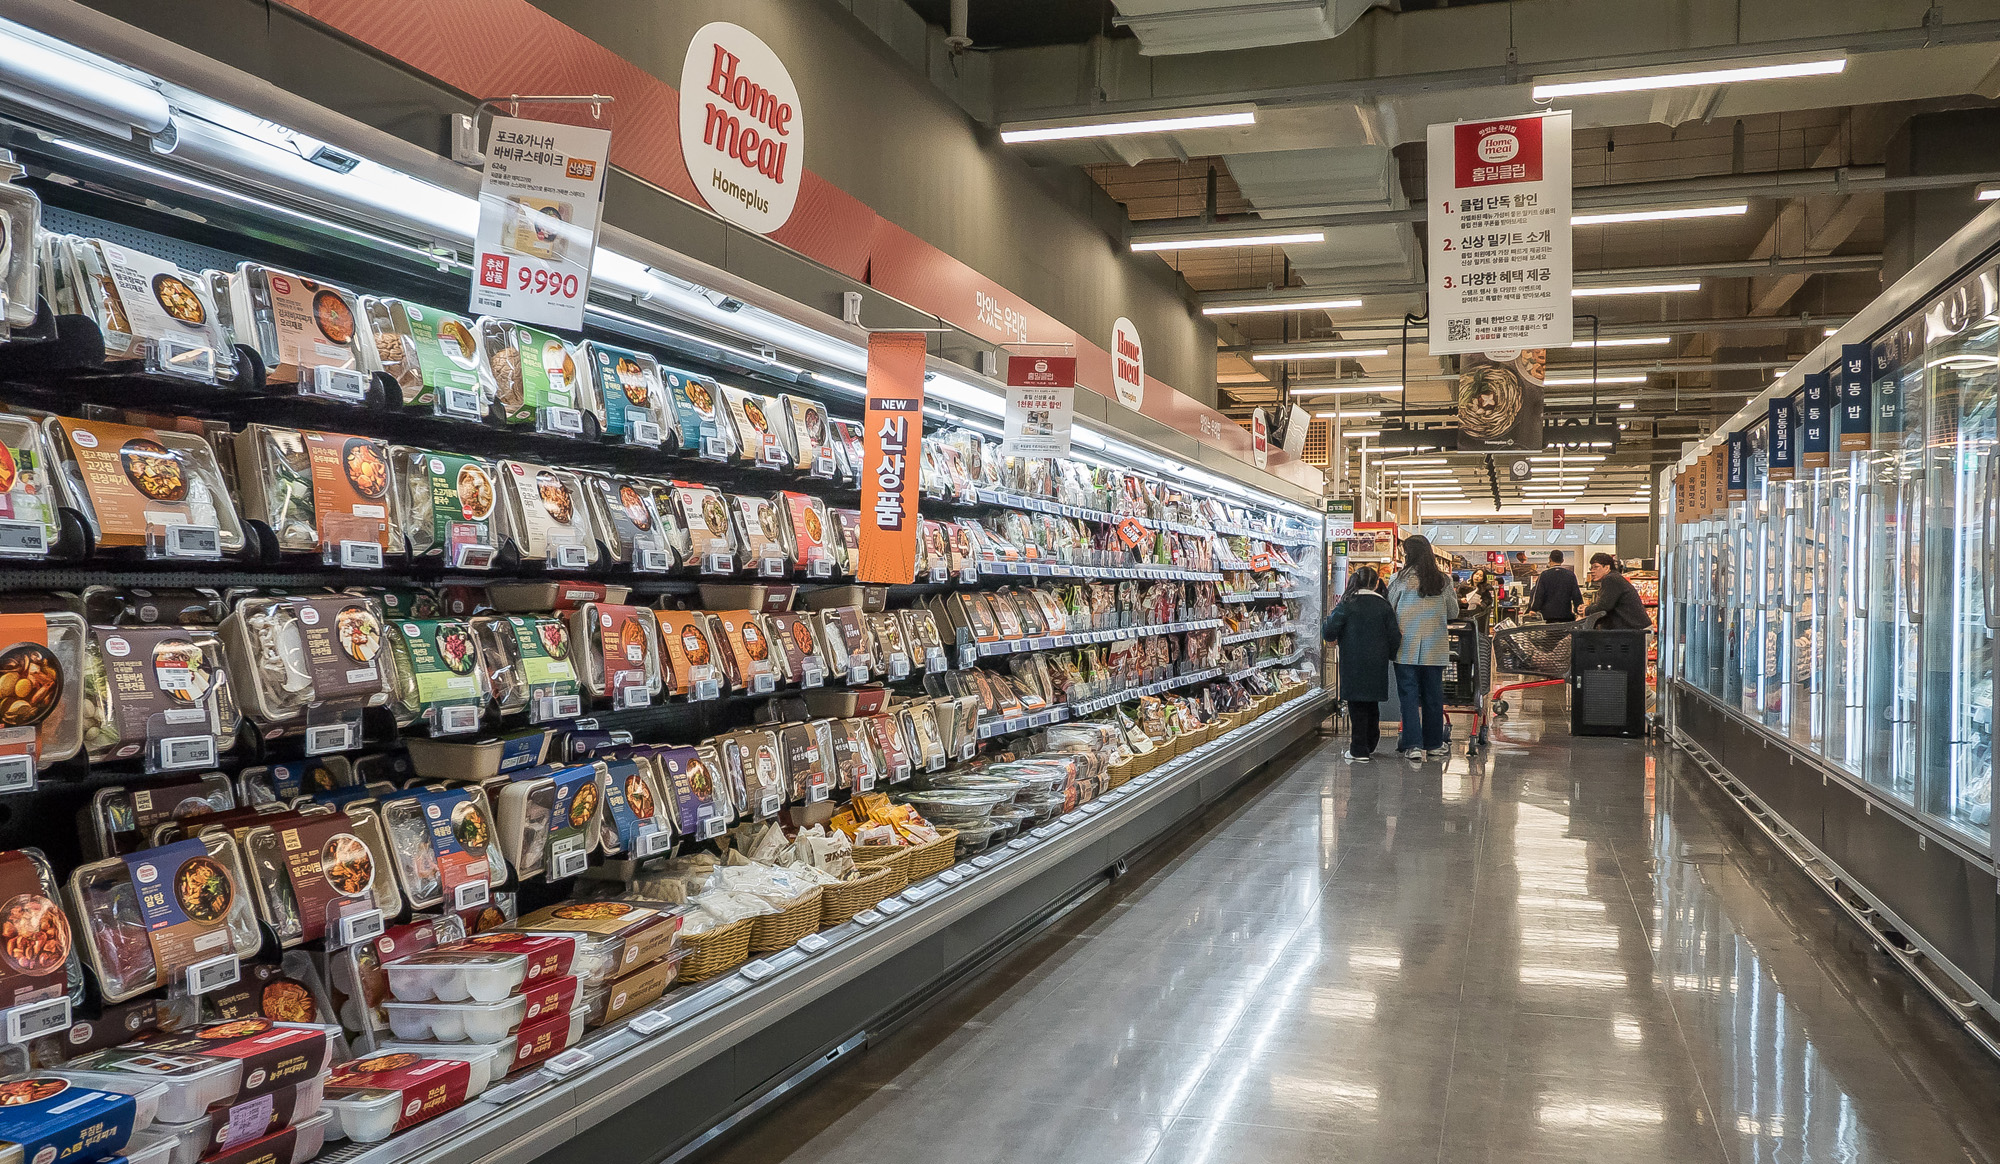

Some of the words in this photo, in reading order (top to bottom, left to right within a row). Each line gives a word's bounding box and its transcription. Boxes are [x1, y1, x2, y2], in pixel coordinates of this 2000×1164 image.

[707, 44, 792, 136] Home
[1479, 126, 1497, 136] 맛있는
[1499, 125, 1517, 134] 우리집
[496, 131, 554, 150] 포크&가니쉬
[704, 103, 788, 184] meal
[1485, 139, 1513, 147] Home
[494, 146, 563, 166] 바비큐스테이크
[1485, 146, 1512, 155] meal
[491, 162, 507, 172] 624g
[568, 161, 593, 176] 신상품
[1473, 163, 1525, 182] 홈밀클럽
[712, 168, 769, 214] Homeplus
[1443, 201, 1454, 214] 1.
[1460, 198, 1484, 212] 클럽
[1487, 195, 1511, 209] 단독
[1514, 193, 1538, 207] 할인
[1443, 239, 1456, 251] 2.
[1461, 235, 1485, 249] 신상
[1488, 233, 1523, 247] 밀키트
[1526, 230, 1550, 243] 소개
[486, 259, 504, 272] 추천
[485, 271, 503, 284] 상품
[519, 266, 578, 299] 9,990
[1444, 277, 1456, 288] 3.
[1461, 272, 1497, 286] 다양한
[1500, 270, 1524, 283] 혜택
[1527, 268, 1551, 281] 제공
[1523, 291, 1551, 299] 받아보세요
[280, 319, 304, 331] 요리재료
[976, 290, 1003, 331] 맛있는
[1004, 307, 1027, 343] 우리집
[1475, 317, 1489, 325] 클릭
[1491, 315, 1519, 324] 한번으로
[1521, 314, 1535, 322] 무료
[1538, 313, 1554, 321] 가입!
[1117, 329, 1139, 362] Home
[1117, 358, 1140, 386] meal
[1848, 359, 1861, 419] 냉동밥
[881, 399, 907, 410] NEW
[1017, 400, 1033, 408] 1천원
[1049, 401, 1062, 409] 할인
[1809, 387, 1820, 440] 냉동면
[1776, 407, 1787, 460] 냉동밀키트
[85, 460, 115, 473] 고깃집
[1732, 441, 1741, 482] 냉동밀키트
[90, 473, 129, 486] 된장찌개
[874, 415, 906, 528] 신상품
[118, 682, 146, 692] 두부전골
[5, 773, 26, 781] 9,990
[144, 892, 165, 908] 알탕
[42, 1014, 65, 1025] 15,990
[74, 1026, 88, 1034] Home
[80, 1122, 104, 1140] 푸짐한
[84, 1126, 118, 1148] 부대찌개
